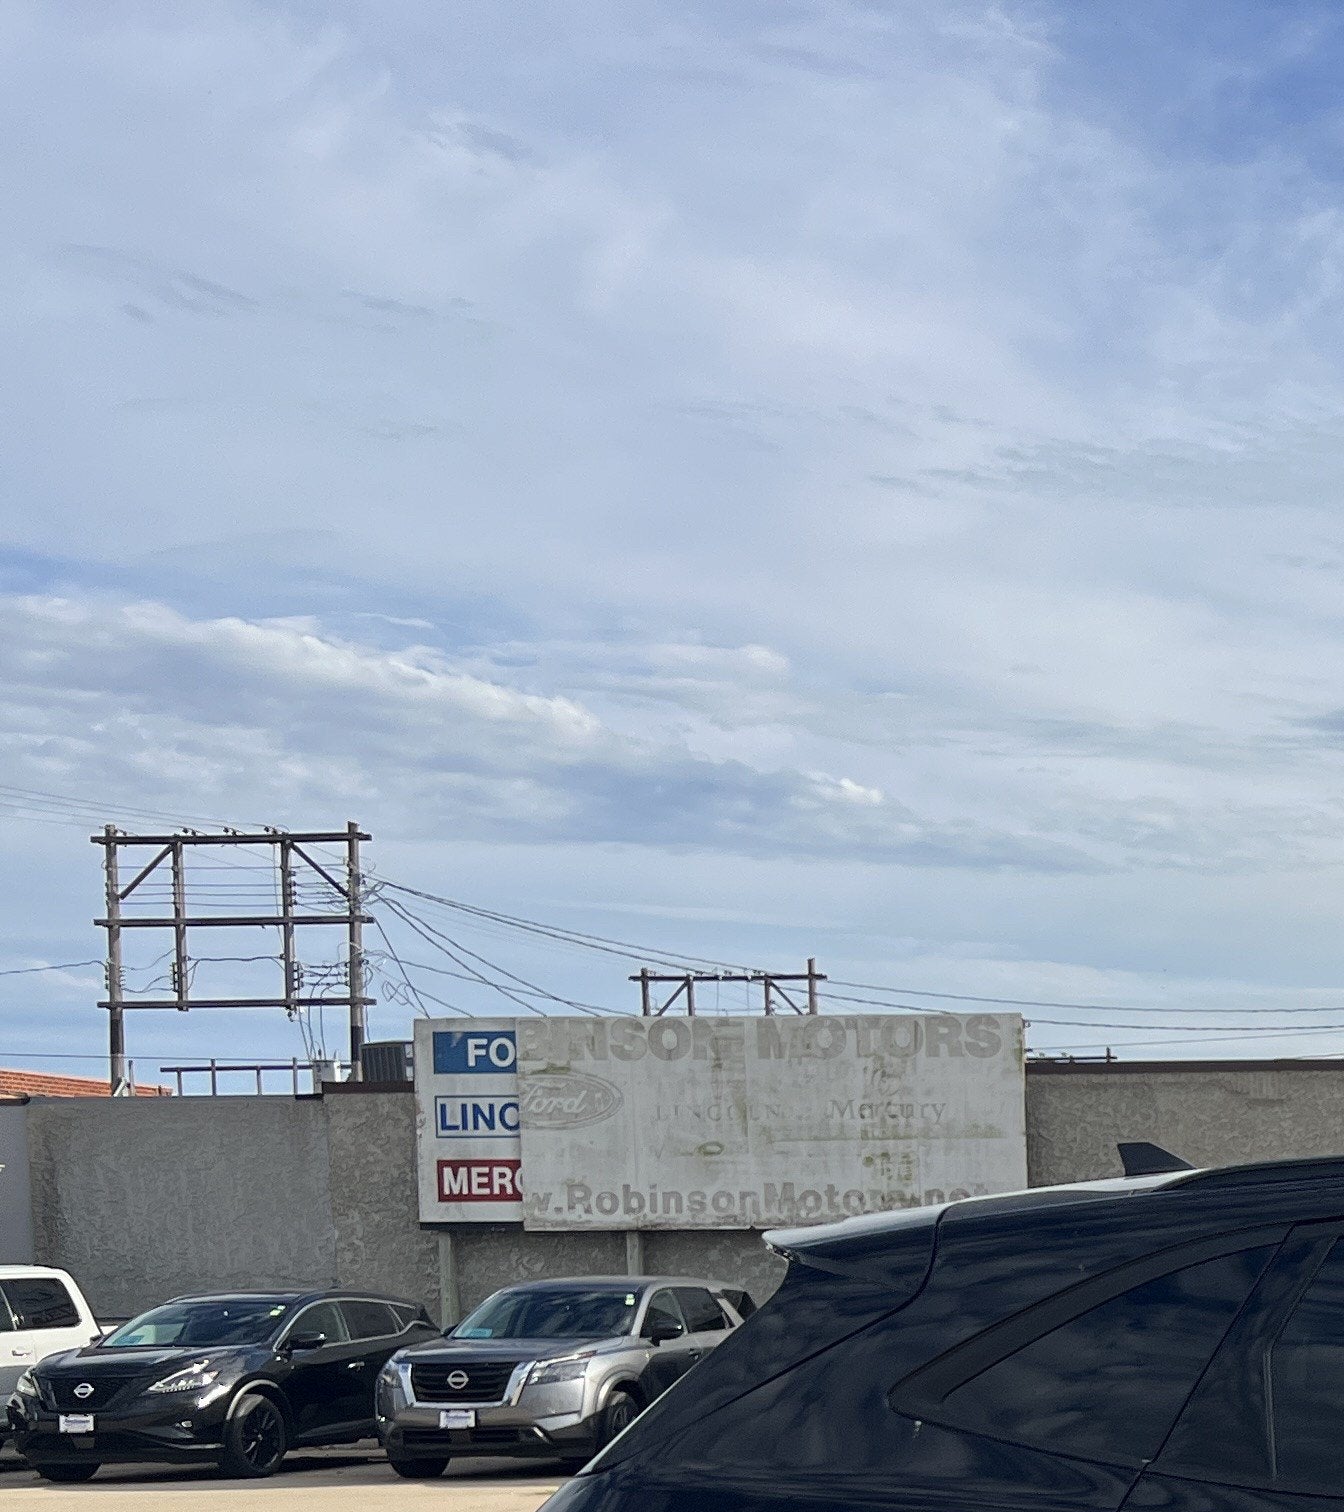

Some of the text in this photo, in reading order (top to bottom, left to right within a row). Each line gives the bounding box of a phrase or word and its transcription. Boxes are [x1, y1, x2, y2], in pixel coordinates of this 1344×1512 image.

[467, 1037, 517, 1068] FO
[756, 1015, 1002, 1059] MOTORS
[825, 1099, 948, 1125] Mercury
